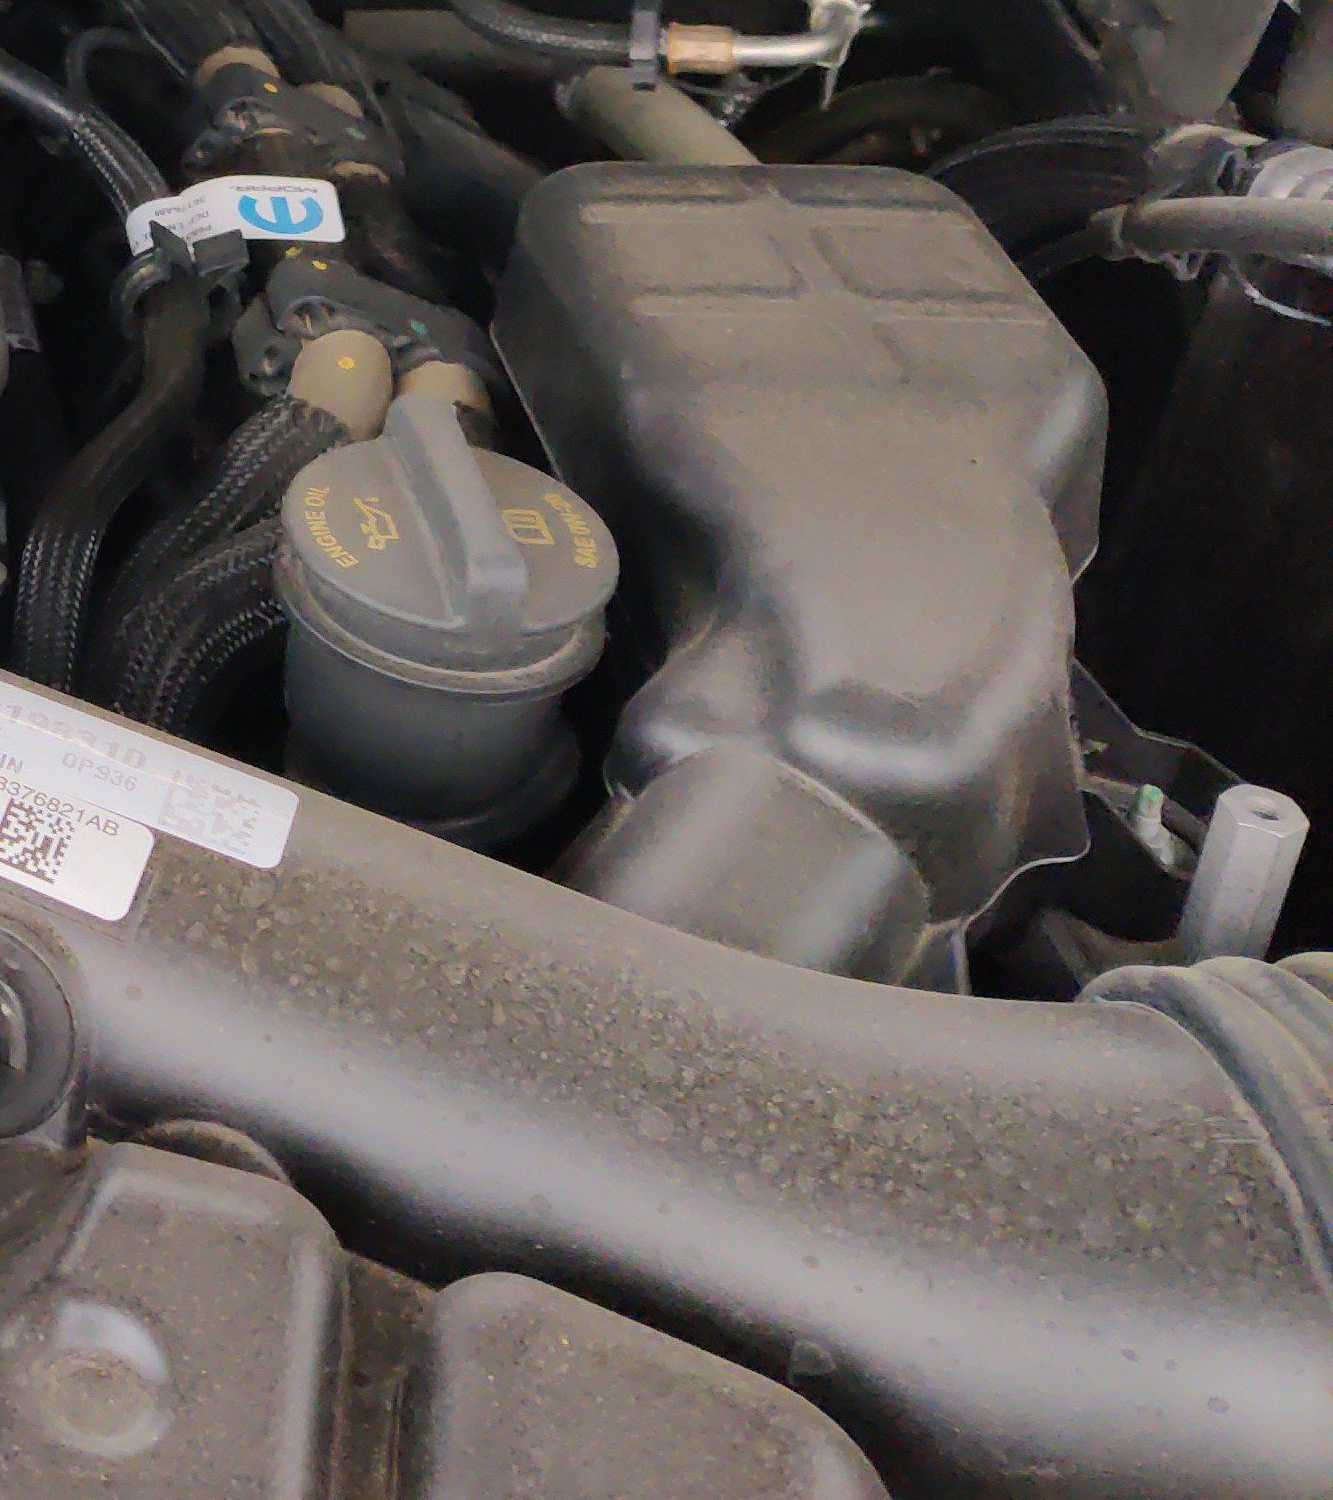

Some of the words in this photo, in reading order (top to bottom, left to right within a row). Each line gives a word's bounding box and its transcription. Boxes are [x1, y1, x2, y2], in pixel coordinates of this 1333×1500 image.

[304, 485, 330, 508] OIL
[304, 510, 360, 569] ENGINE
[573, 538, 599, 570] SAE
